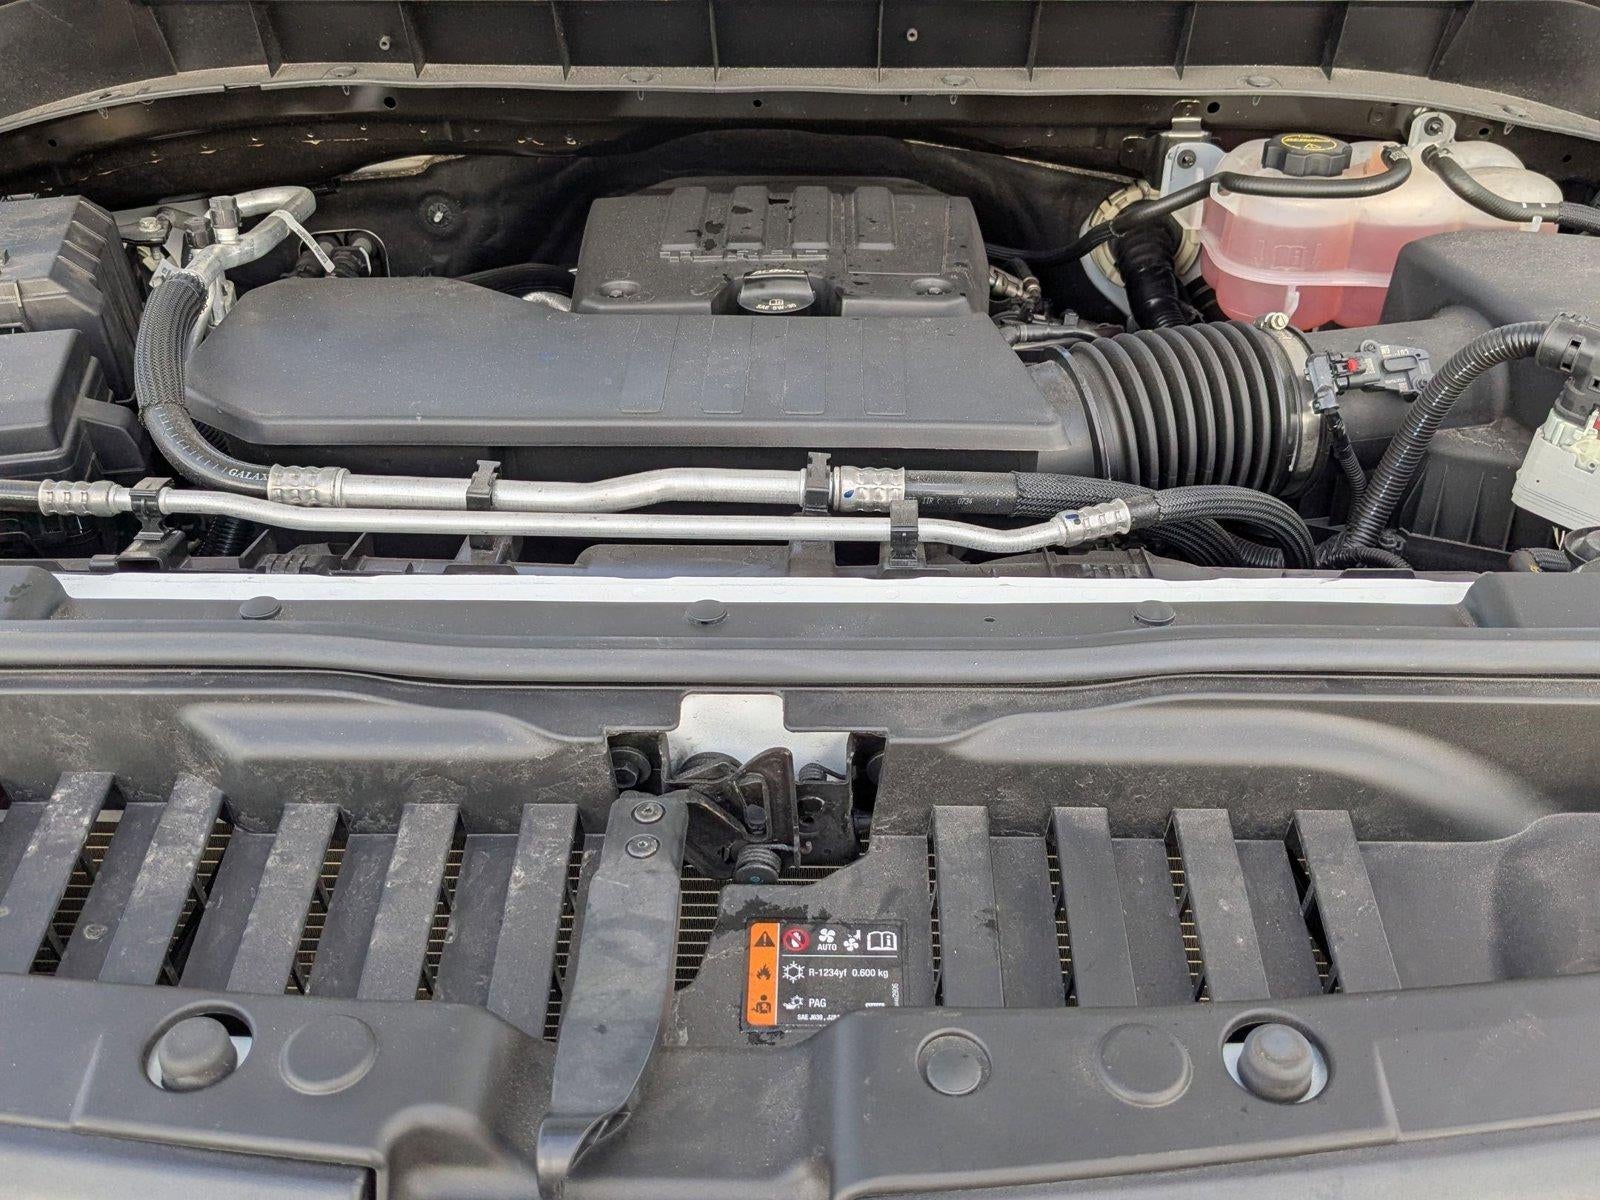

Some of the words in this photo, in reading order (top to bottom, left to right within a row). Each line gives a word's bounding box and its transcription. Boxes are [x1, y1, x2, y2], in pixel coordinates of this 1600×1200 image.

[817, 943, 837, 951] AUTO
[808, 968, 847, 979] R-1234yf
[851, 968, 876, 977] 0.600
[877, 968, 889, 979] kg
[808, 998, 827, 1008] PAG
[797, 1013, 809, 1021] SAE
